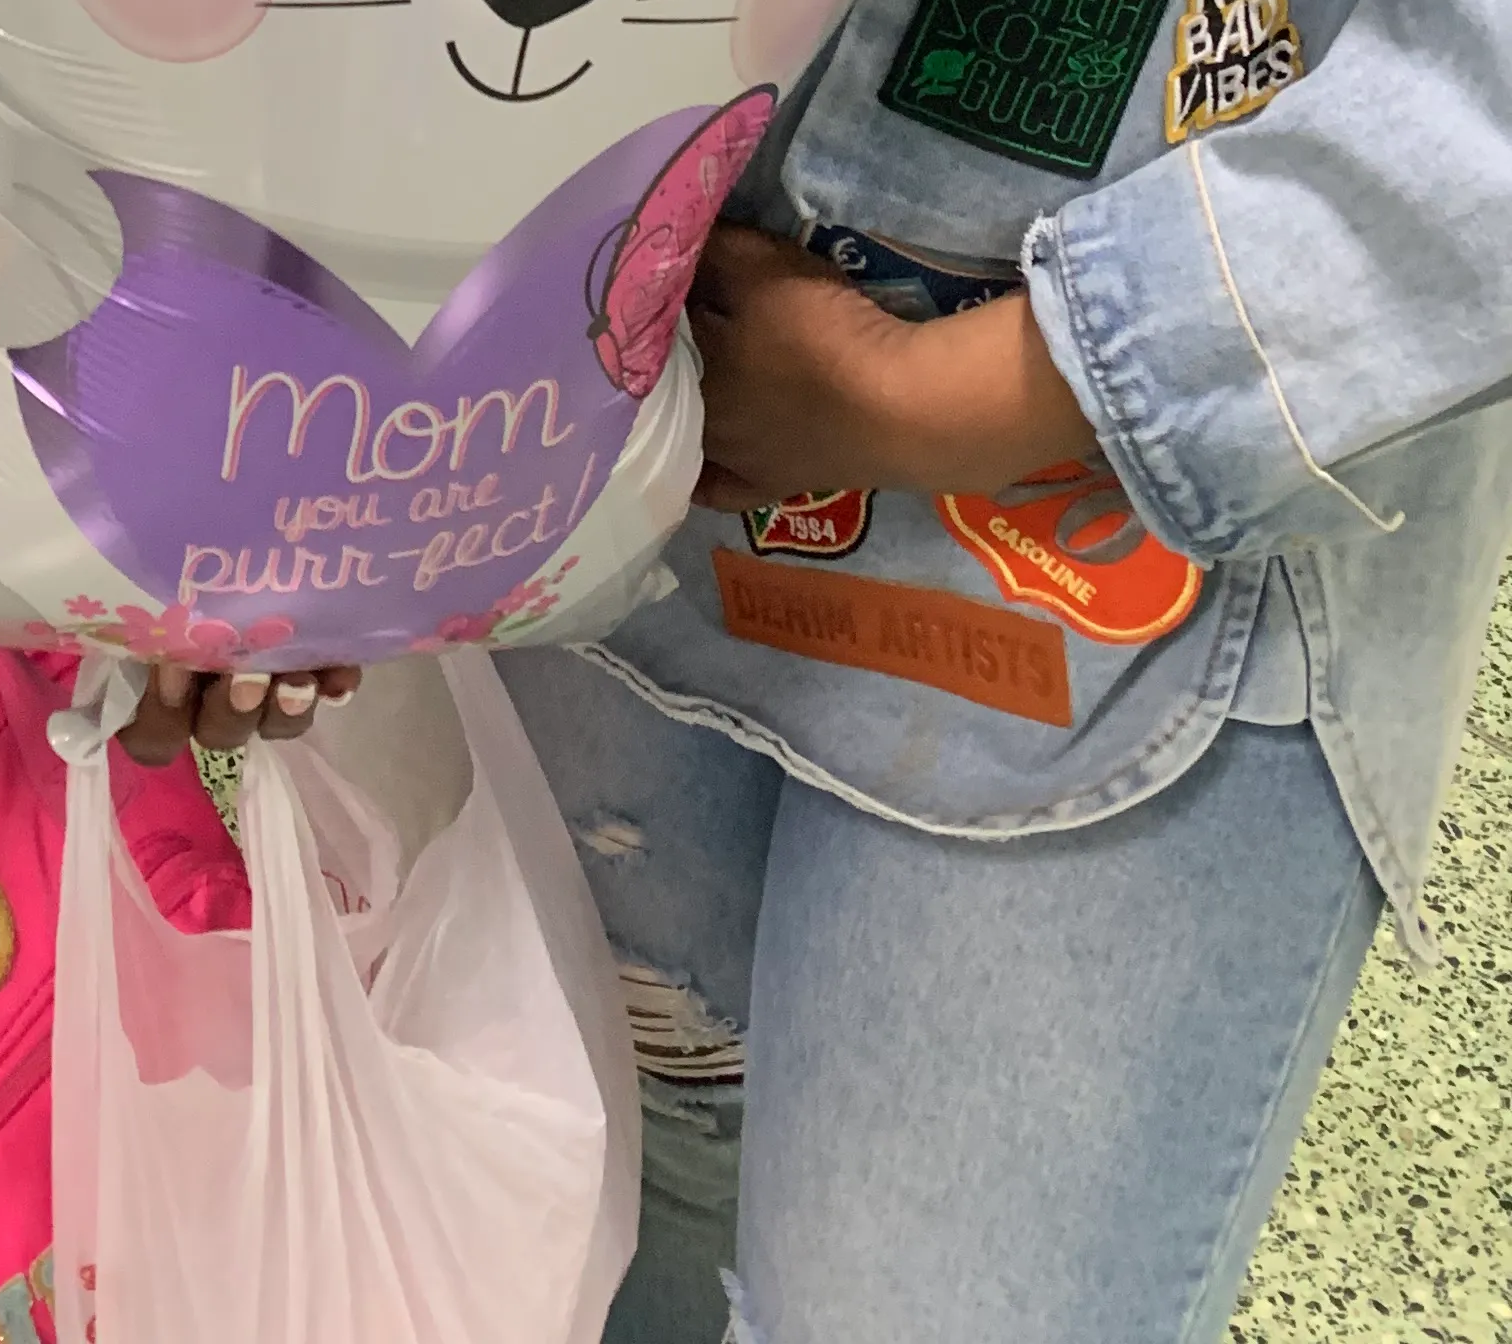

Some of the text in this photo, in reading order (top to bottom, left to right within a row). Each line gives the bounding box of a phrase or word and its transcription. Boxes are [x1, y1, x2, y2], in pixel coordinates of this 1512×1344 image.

[1171, 39, 1299, 134] VIBES
[274, 473, 505, 542] you are
[987, 515, 1098, 607] GASOLINE
[878, 610, 1057, 699] ARTISTS
